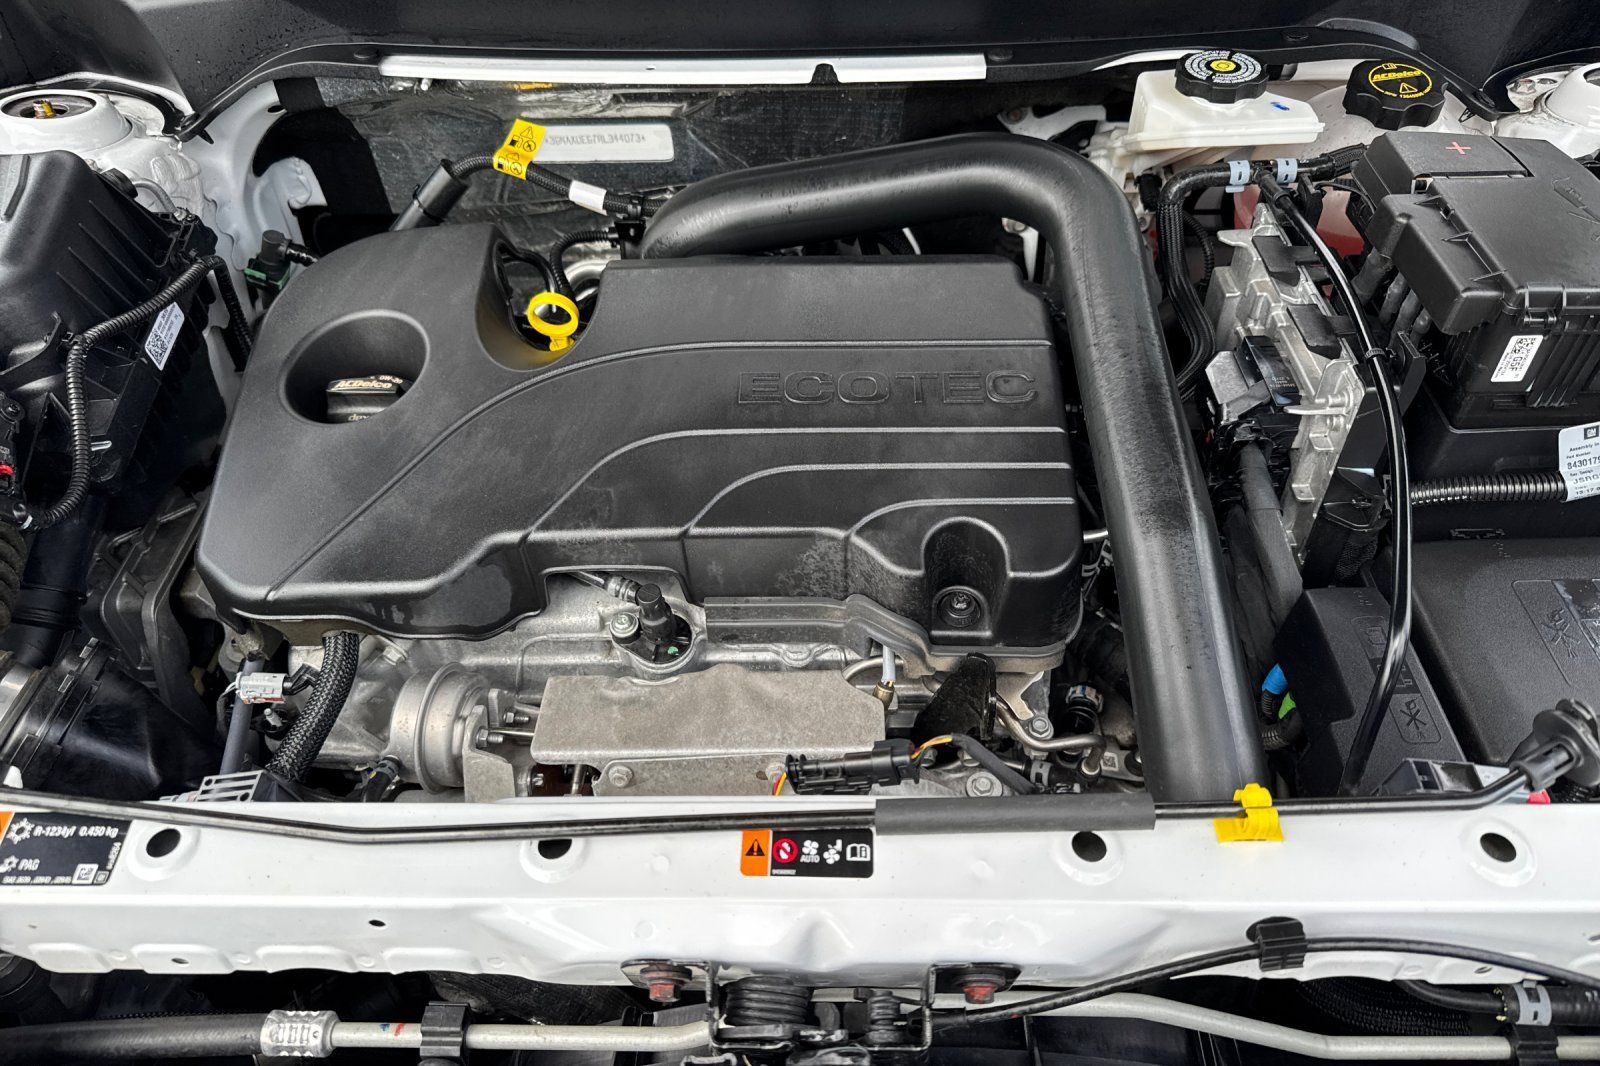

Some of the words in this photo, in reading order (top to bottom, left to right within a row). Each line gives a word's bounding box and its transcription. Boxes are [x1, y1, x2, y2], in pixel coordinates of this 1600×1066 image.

[737, 369, 1039, 404] ECOTEC
[1586, 427, 1597, 438] GM
[79, 826, 105, 837] 0.450
[105, 826, 119, 839] kg
[18, 858, 41, 871] PAG
[799, 854, 821, 864] AUTO
